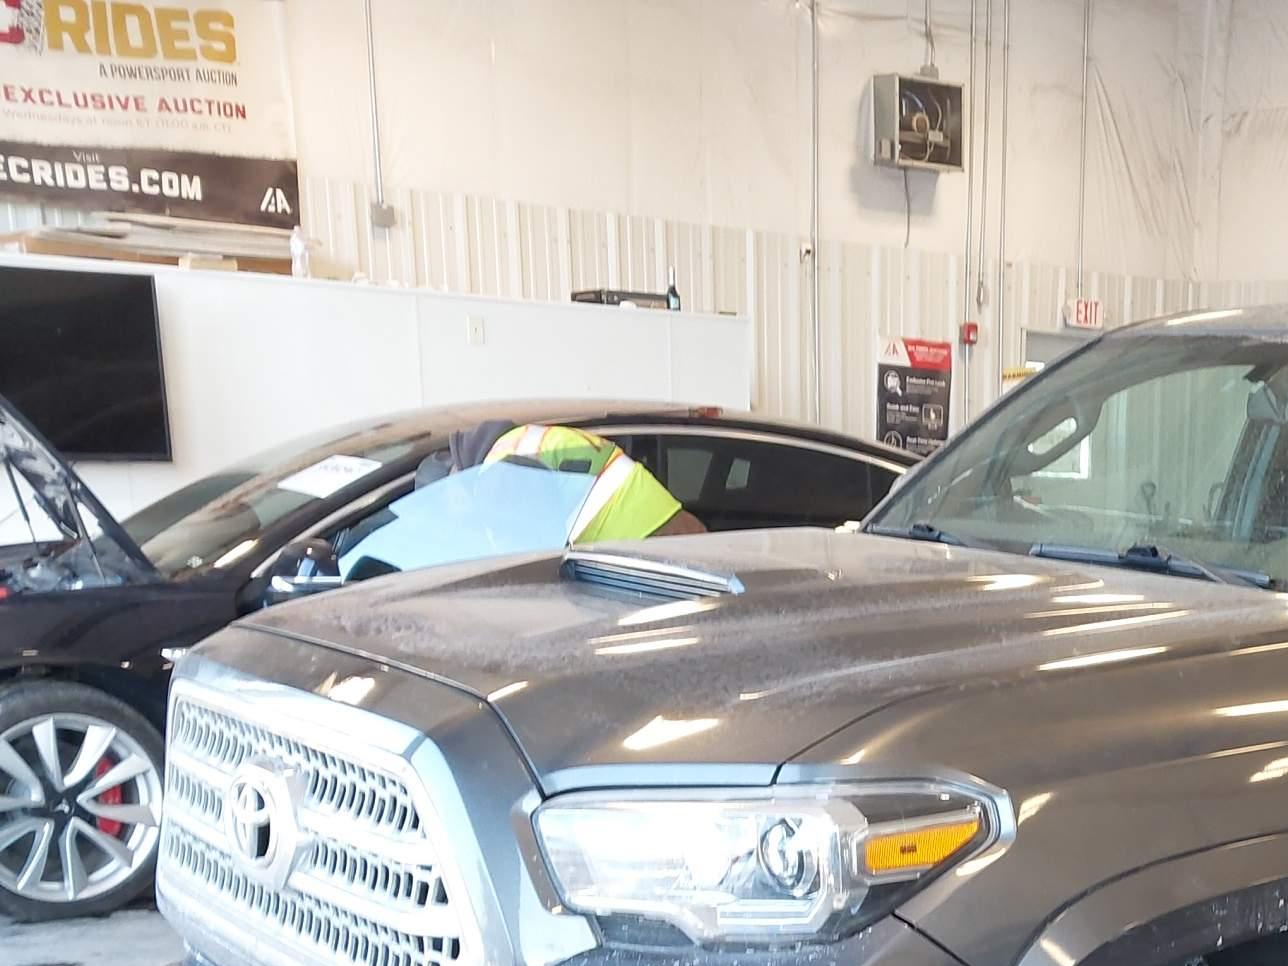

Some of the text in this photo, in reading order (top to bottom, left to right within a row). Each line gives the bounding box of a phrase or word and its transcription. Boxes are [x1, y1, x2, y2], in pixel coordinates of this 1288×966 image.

[43, 0, 238, 64] RIDES
[110, 64, 191, 82] POWERSPORT
[195, 68, 238, 87] AUCTION
[2, 84, 247, 120] EXCLUSIVE AUCTION
[1076, 300, 1099, 326] EXIT
